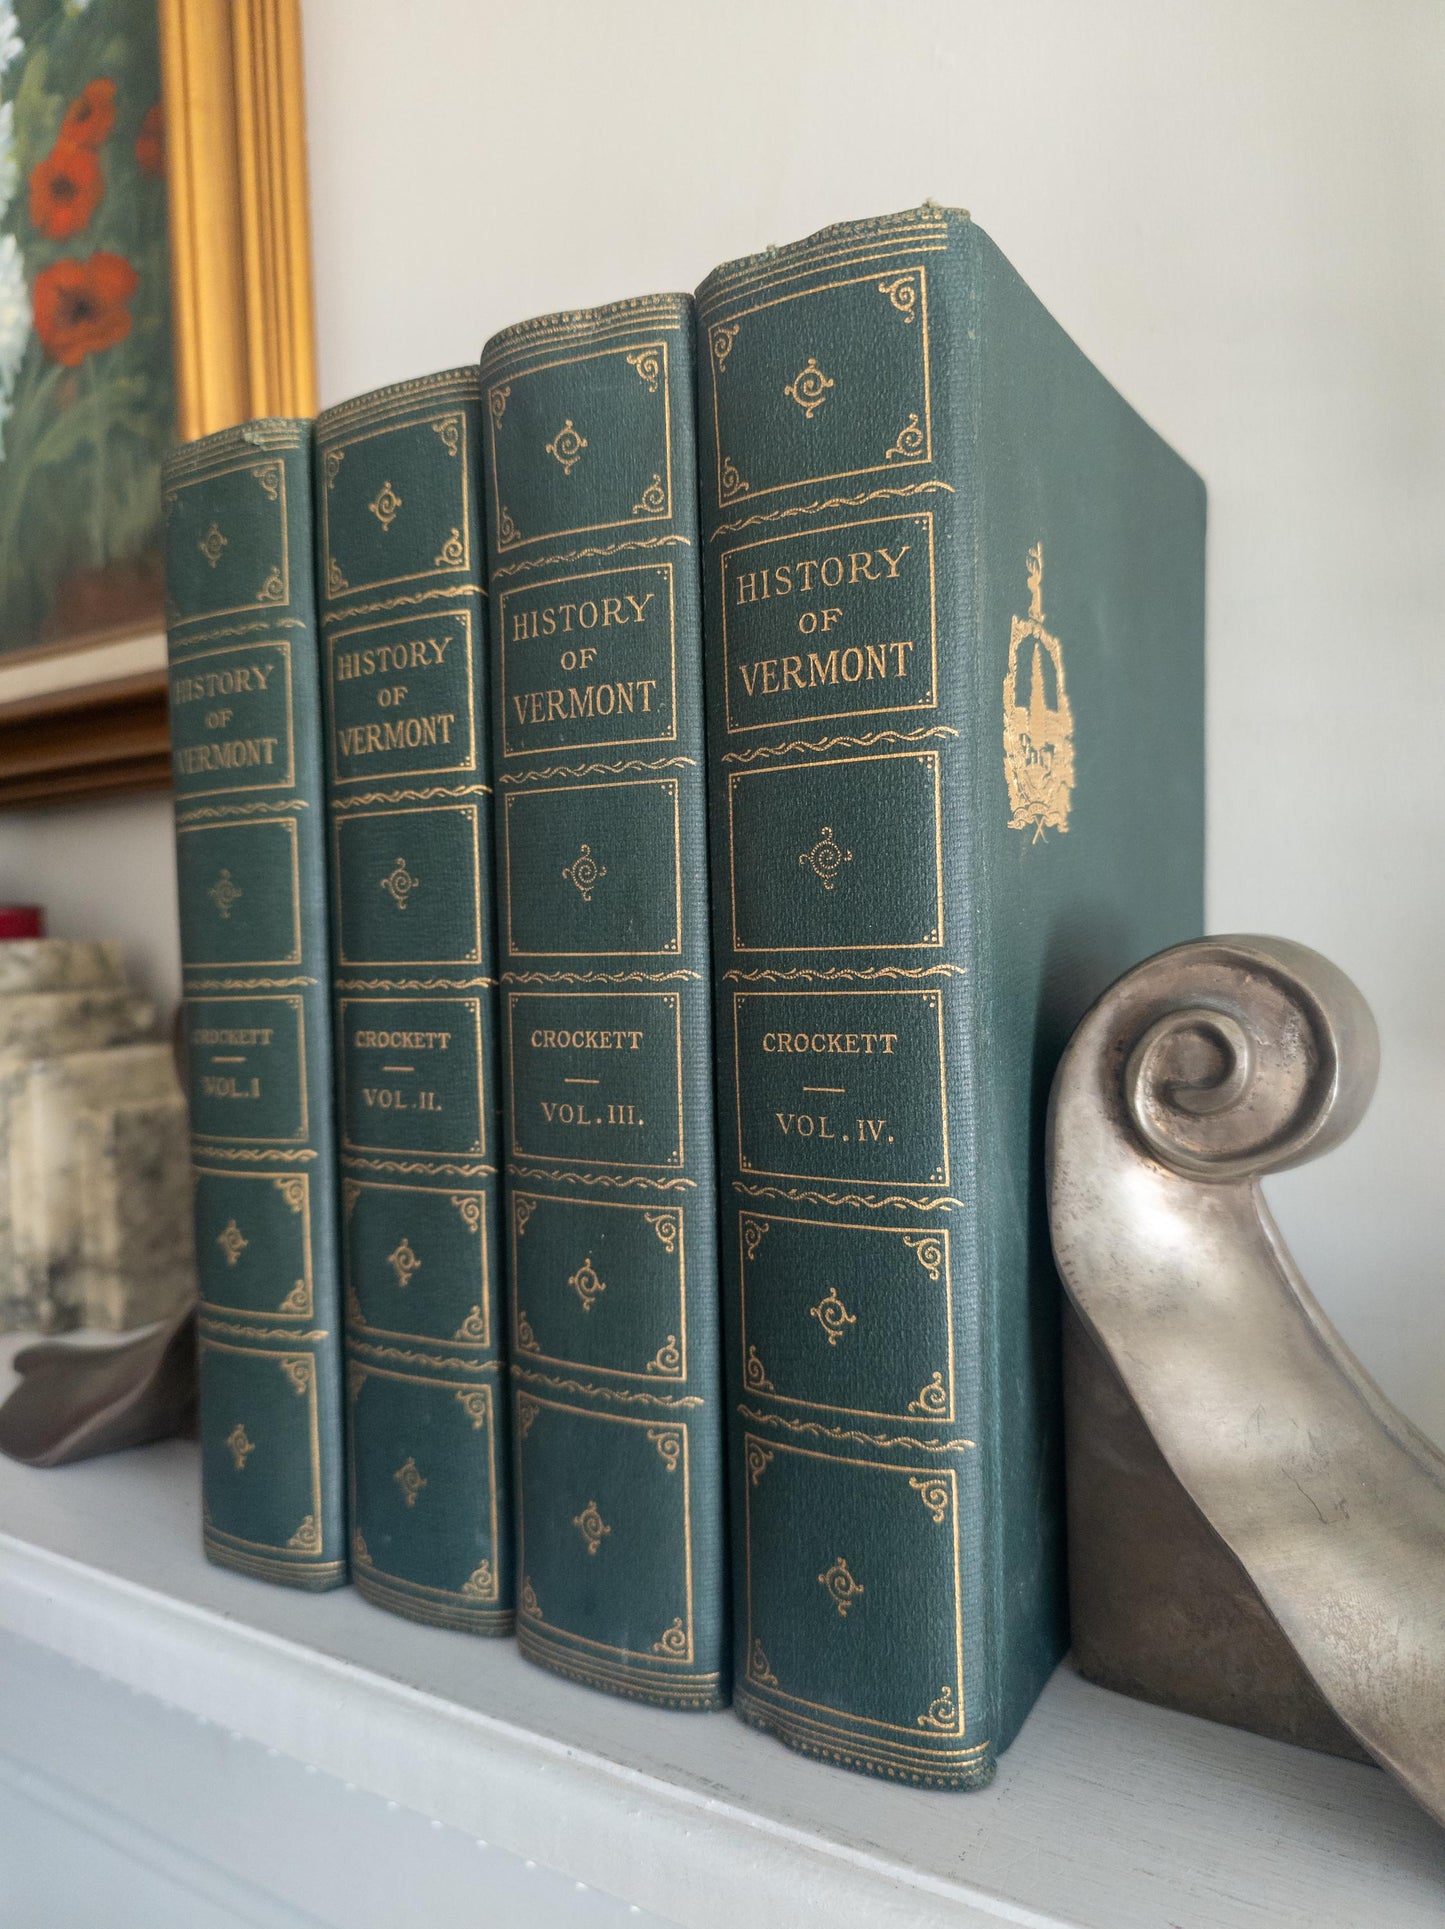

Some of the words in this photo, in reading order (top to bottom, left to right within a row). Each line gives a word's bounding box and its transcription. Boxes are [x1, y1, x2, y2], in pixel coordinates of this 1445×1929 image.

[735, 546, 911, 605] HISTORY
[511, 592, 655, 642] HISTORY
[797, 607, 842, 635] OF
[336, 636, 454, 681] HISTORY
[560, 647, 597, 671] OF
[739, 640, 914, 697] VERMONT
[174, 664, 275, 705] HISTORY
[376, 686, 409, 708] OF
[204, 708, 234, 730] OF
[512, 679, 657, 725] VERMONT
[338, 713, 456, 758] VERMONT
[354, 1030, 451, 1049] CROCKETT
[530, 1029, 644, 1050] CROCKETT
[761, 1032, 898, 1055] CROCKETT
